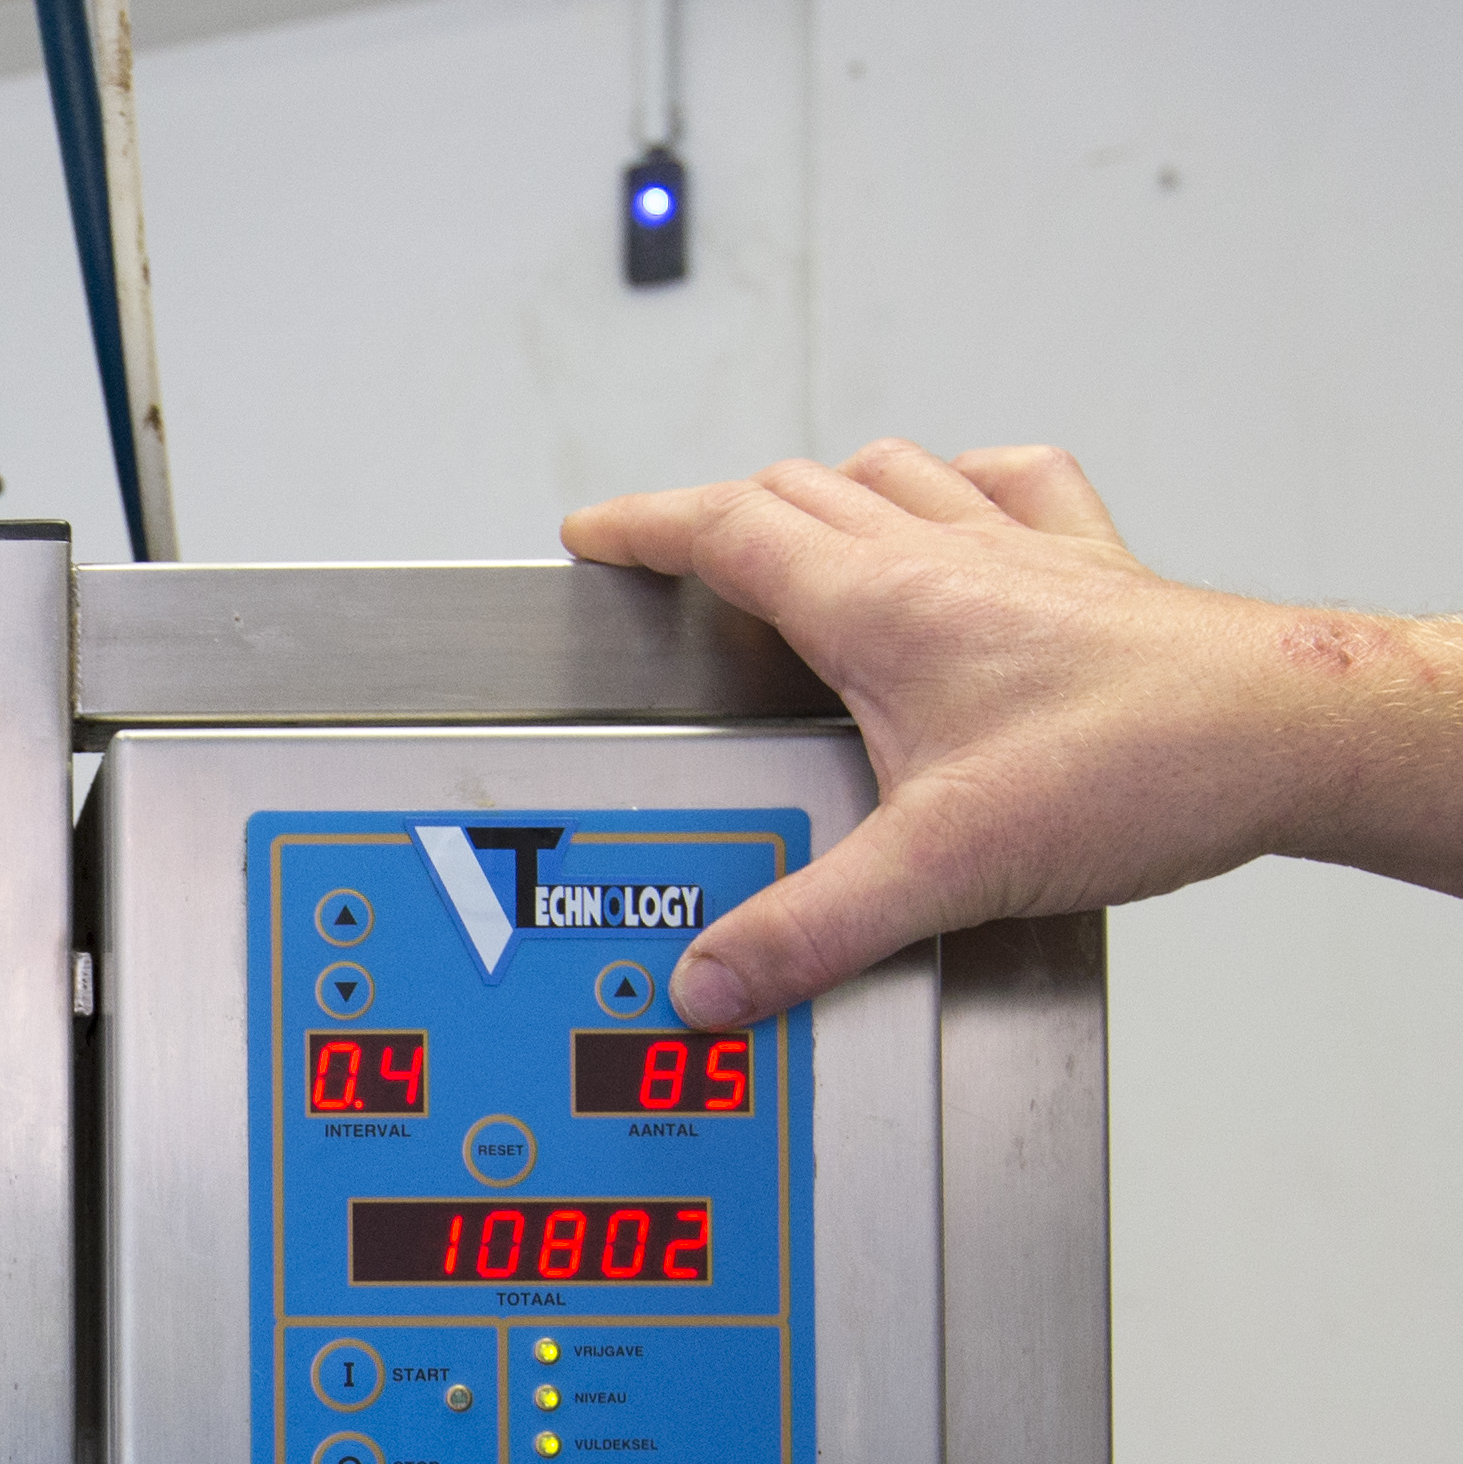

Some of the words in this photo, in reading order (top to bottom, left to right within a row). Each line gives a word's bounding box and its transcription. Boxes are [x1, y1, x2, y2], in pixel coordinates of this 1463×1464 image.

[312, 1042, 424, 1110] 0.4
[638, 1042, 747, 1110] 85
[324, 1124, 411, 1138] INTERVAL
[628, 1123, 699, 1137] AANTAL
[478, 1145, 524, 1156] RESET
[444, 1210, 708, 1279] 10802
[497, 1293, 566, 1306] TOTAAL
[574, 1345, 643, 1358] VRIJGAVE
[392, 1367, 450, 1382] START
[575, 1392, 626, 1404] NIVEAU
[575, 1438, 658, 1451] VULDEKSEL
